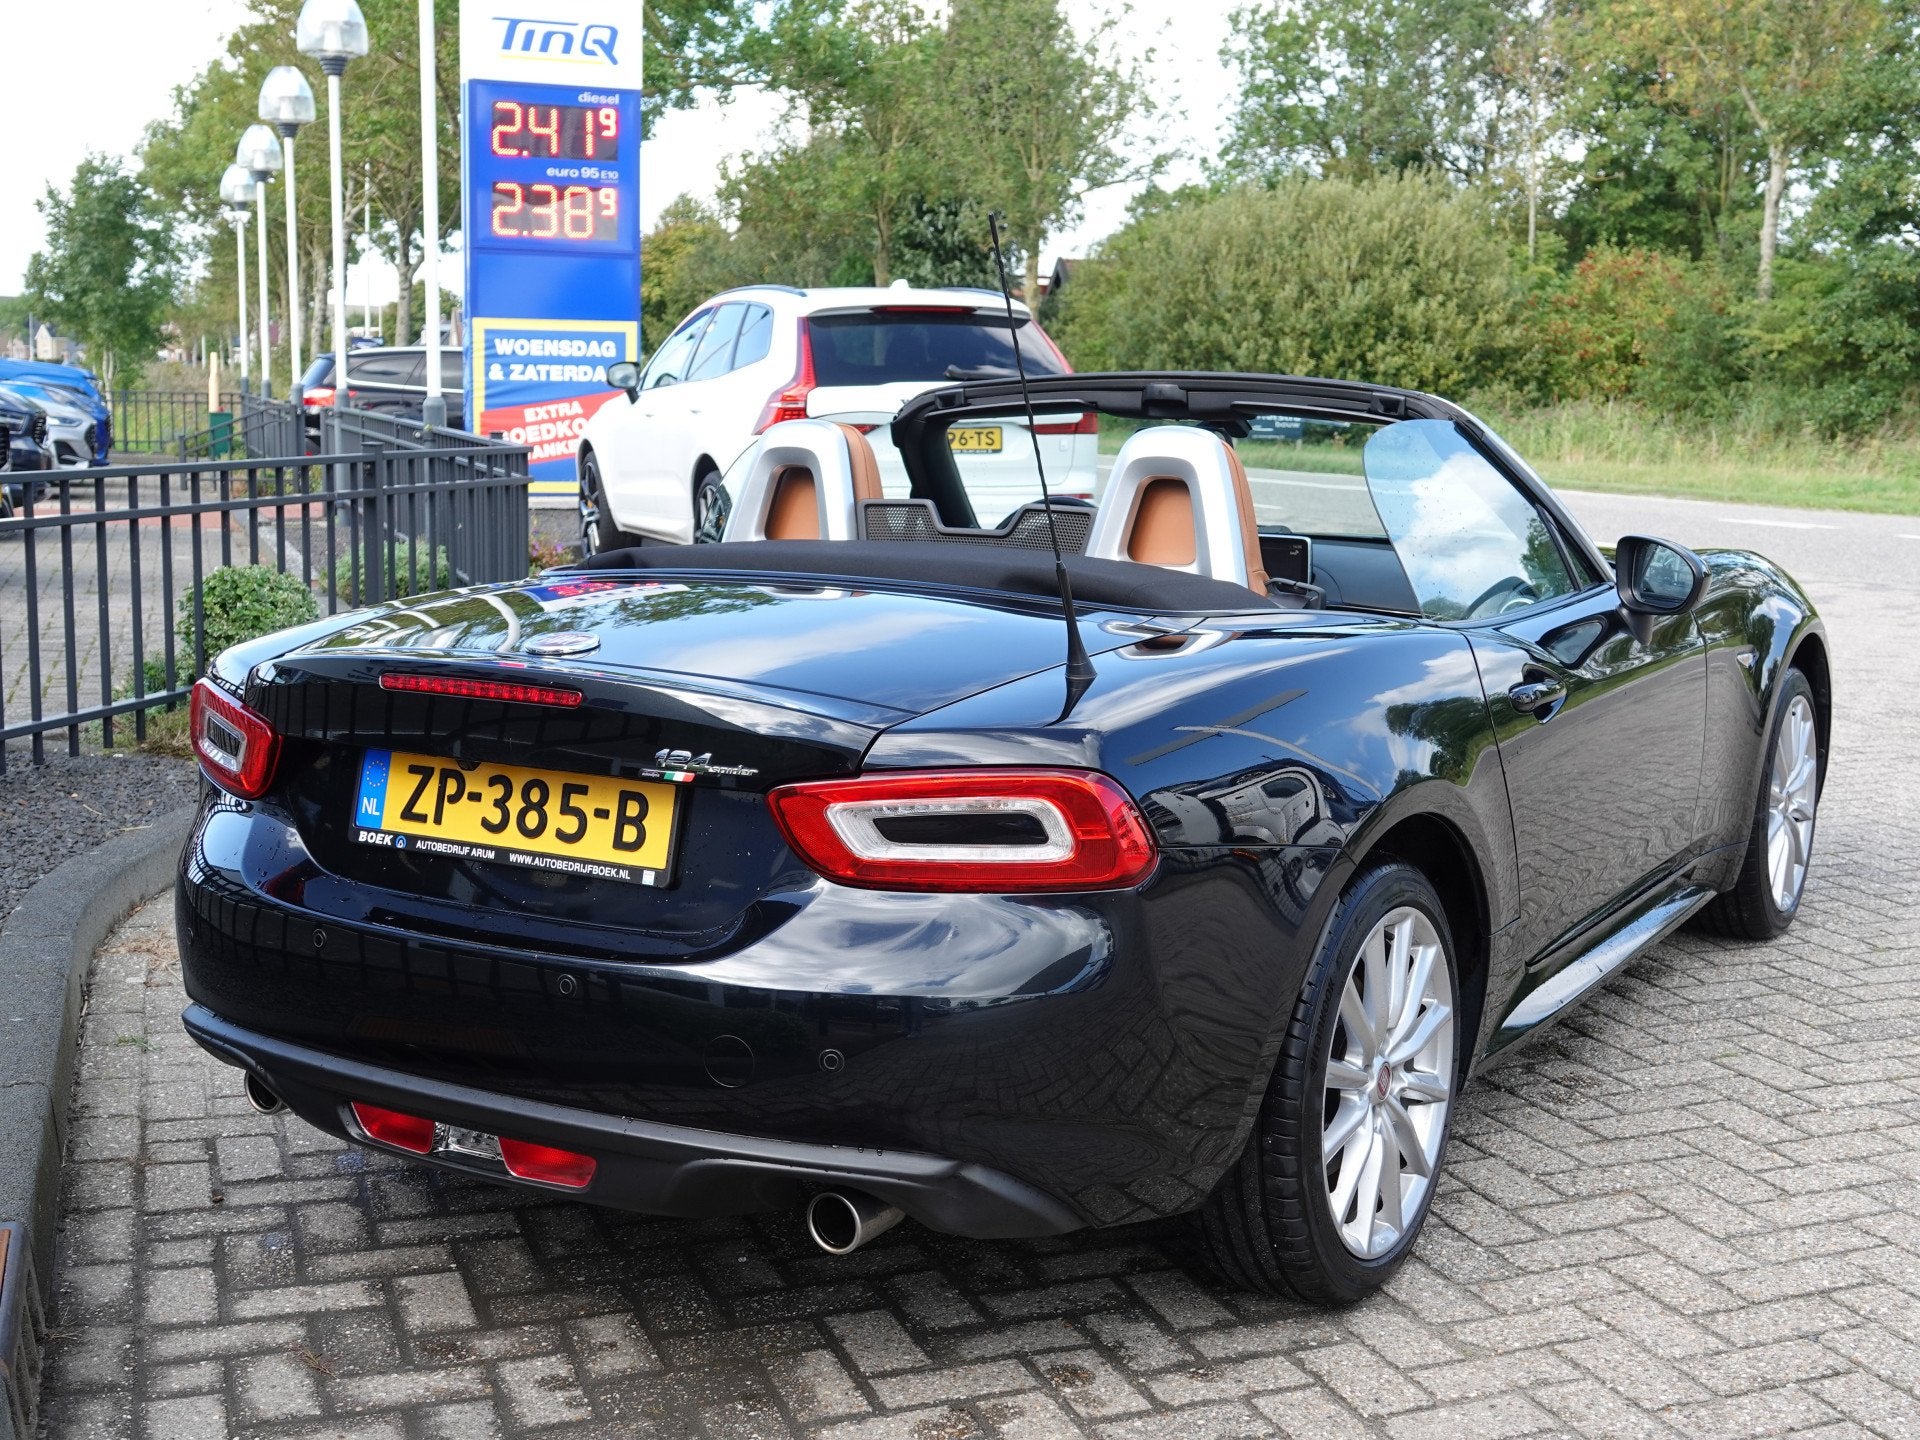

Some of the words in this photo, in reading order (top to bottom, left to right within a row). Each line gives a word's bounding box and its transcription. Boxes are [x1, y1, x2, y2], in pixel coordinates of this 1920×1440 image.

[492, 17, 618, 65] TinQ
[578, 92, 619, 104] diesel
[546, 167, 579, 178] euro
[580, 168, 599, 179] 95
[494, 338, 616, 358] WOENSDAG
[488, 363, 504, 381] &
[509, 363, 608, 382] ZATERDA
[523, 400, 584, 422] EXTRA
[502, 417, 589, 444] OEDKO
[528, 438, 580, 460] ANKE
[655, 748, 712, 770] 124
[361, 796, 380, 816] NL
[399, 763, 649, 853] ZP-385-B
[358, 830, 393, 846] BOEK
[416, 840, 470, 856] AUTOBEDRIJF
[471, 848, 495, 859] ARUM
[509, 852, 631, 880] WWW.AUTOBEDRIJFBOEK.NL
